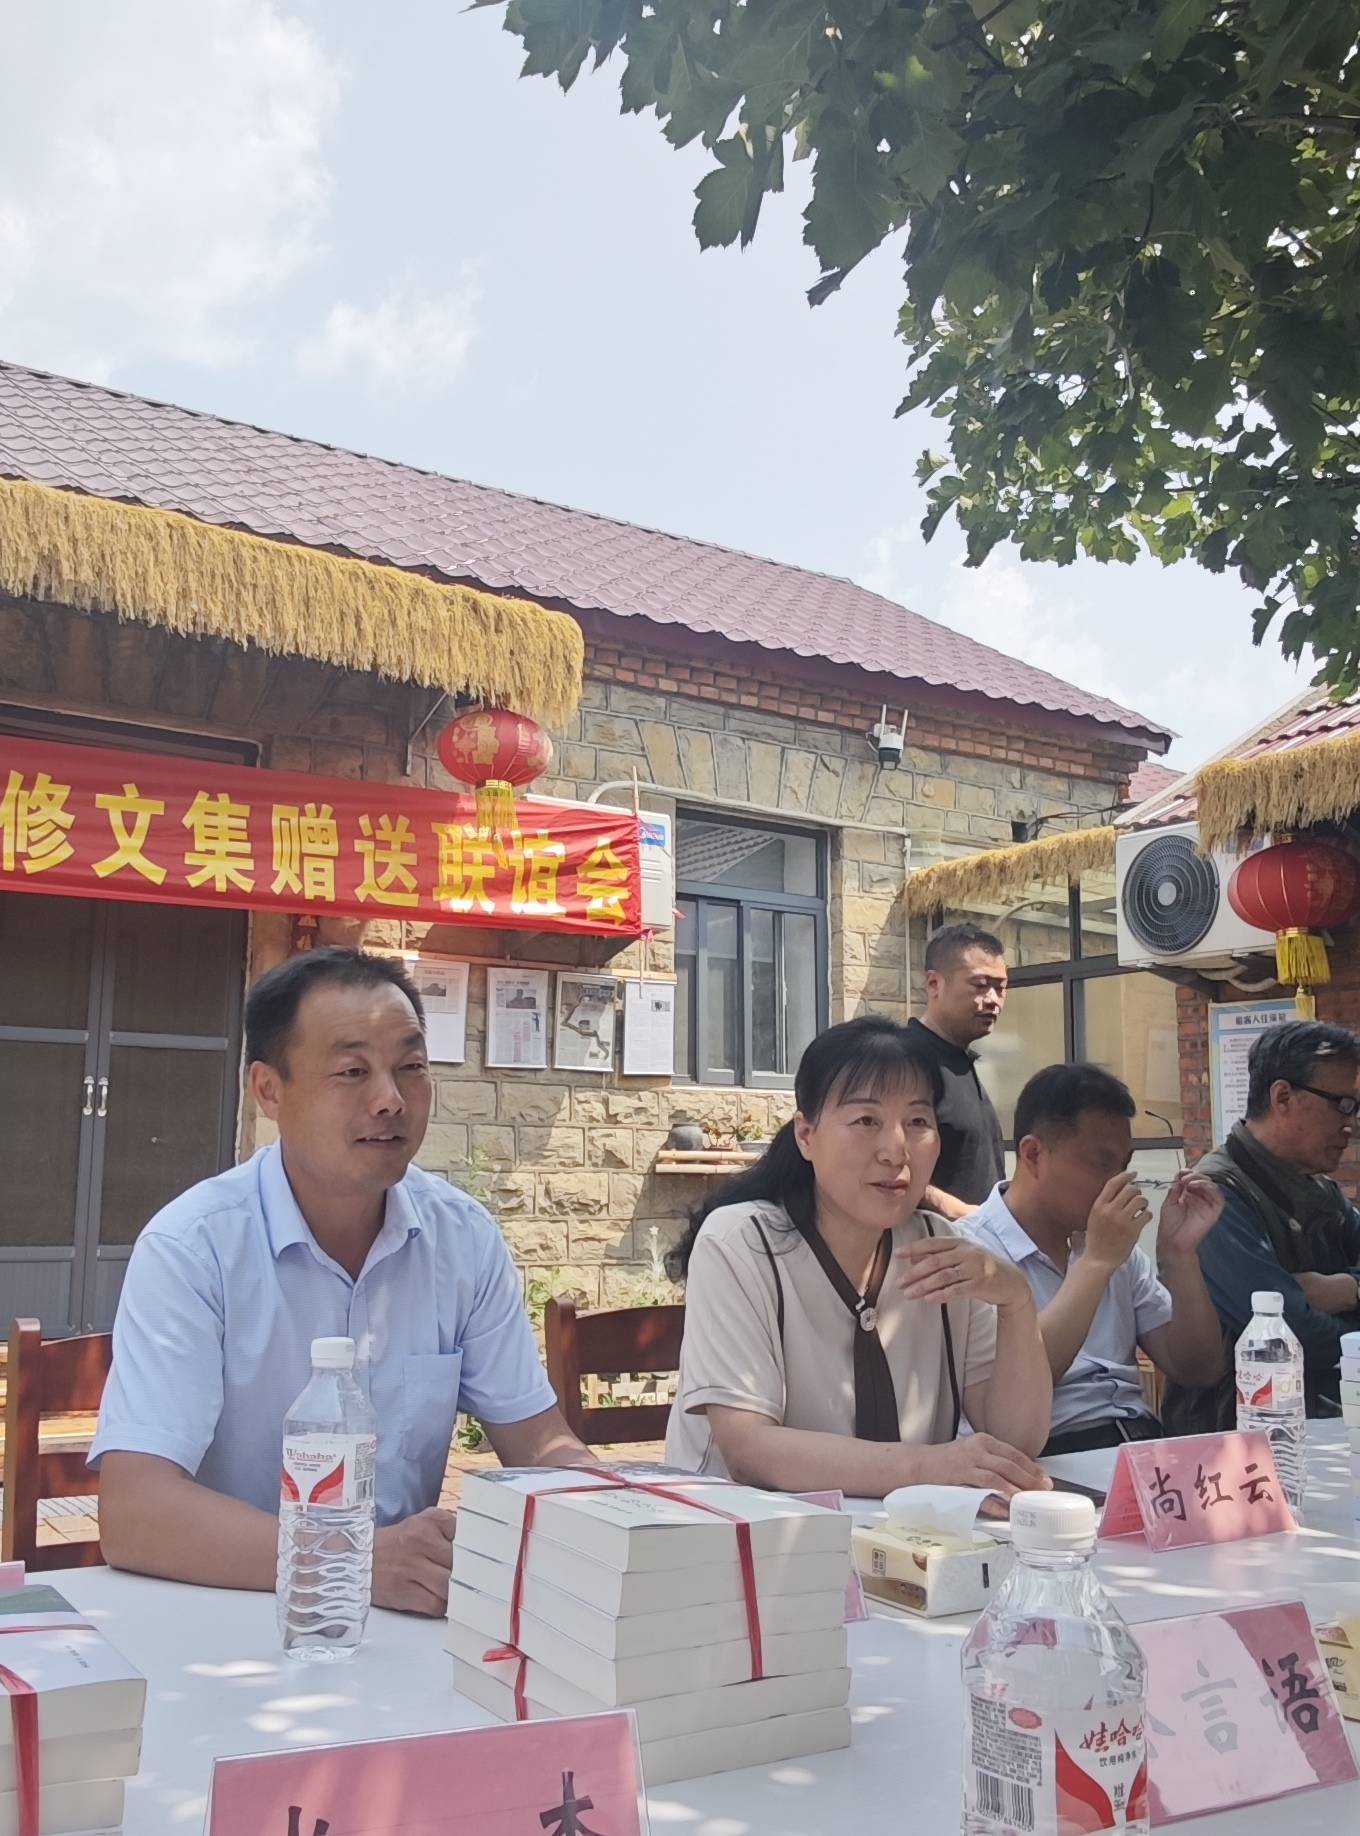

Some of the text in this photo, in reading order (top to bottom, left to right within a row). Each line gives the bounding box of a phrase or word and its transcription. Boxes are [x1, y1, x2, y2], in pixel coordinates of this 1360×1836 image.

[1149, 1463, 1274, 1522] 尚红云
[1148, 1652, 1320, 1756] 言语
[1078, 1716, 1145, 1753] 娃哈哈
